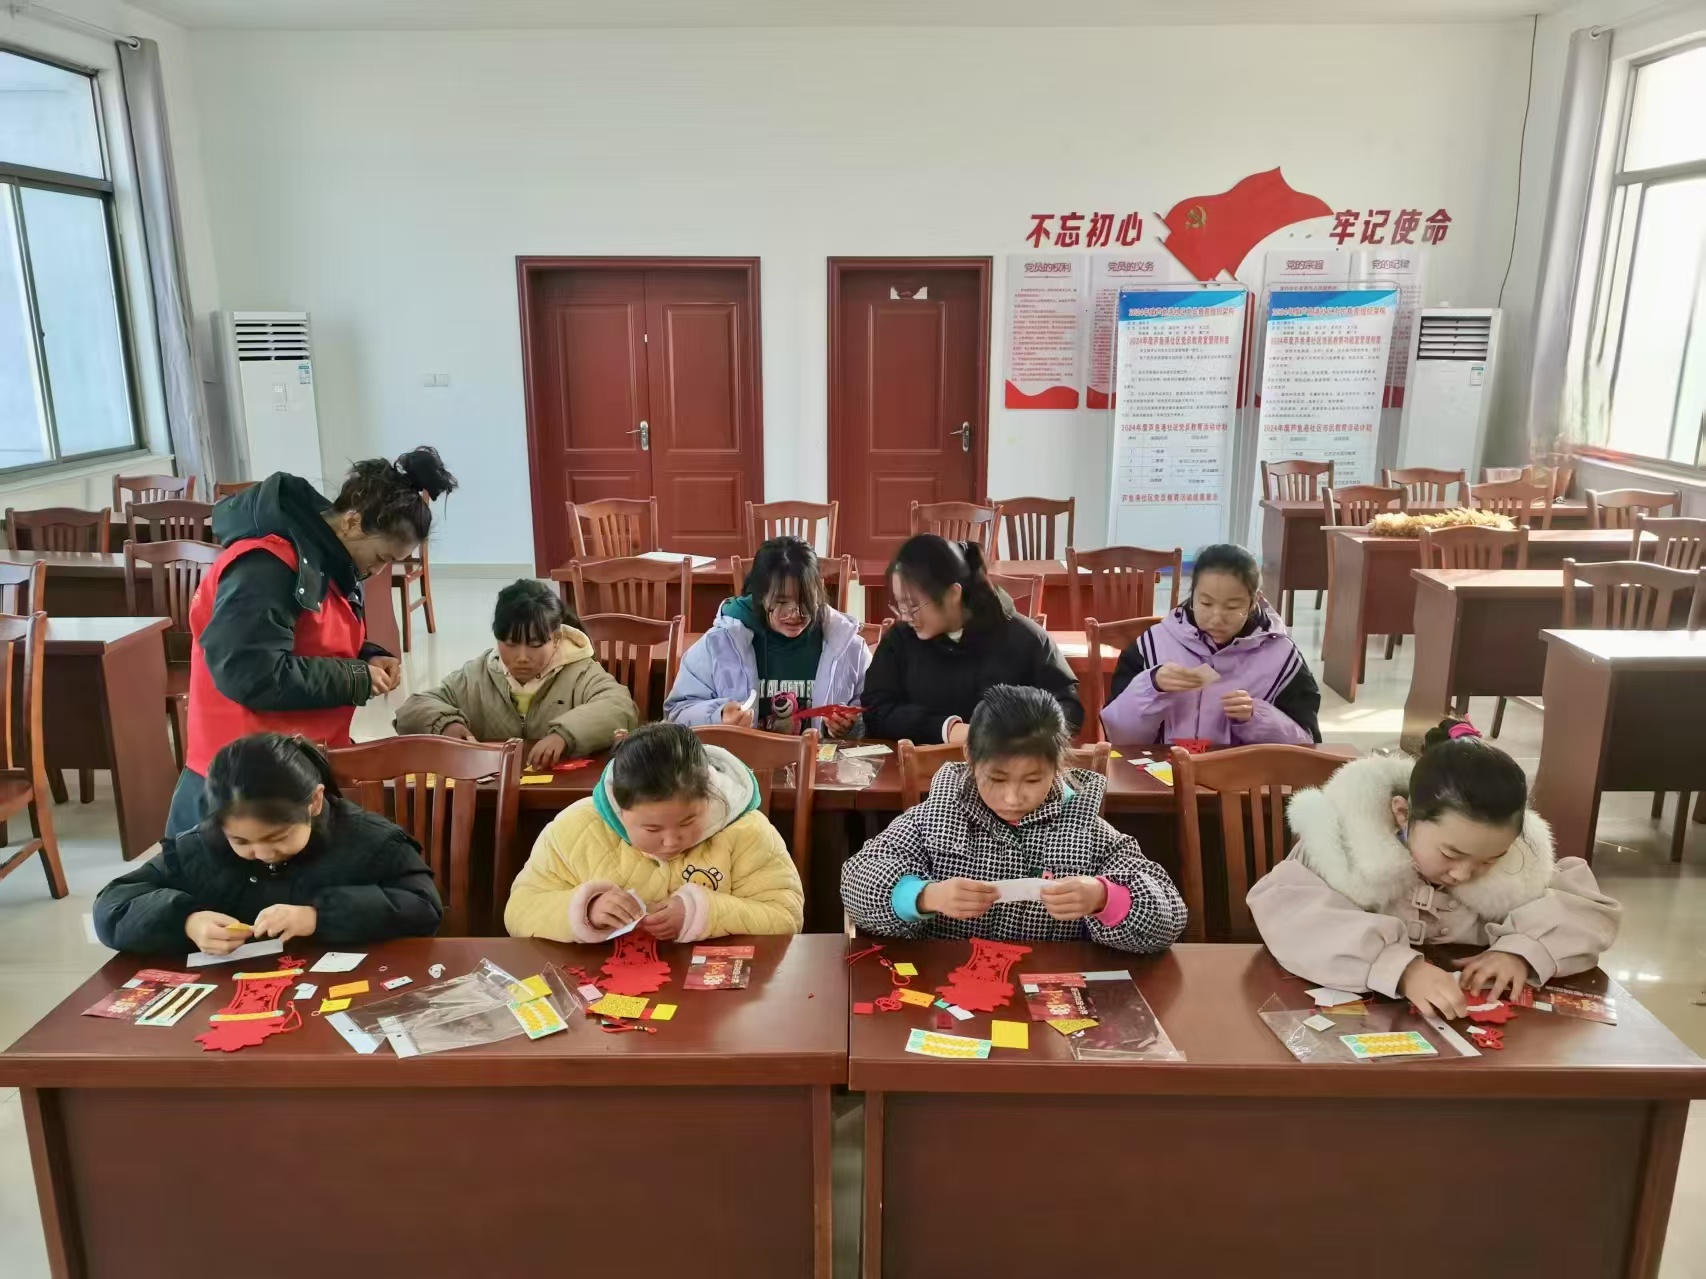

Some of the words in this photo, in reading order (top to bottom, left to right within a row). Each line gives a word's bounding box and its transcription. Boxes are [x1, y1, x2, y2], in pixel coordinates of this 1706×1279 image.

[1025, 211, 1143, 248] 不忘初心
[1329, 208, 1453, 246] 牢记使命
[1024, 262, 1071, 272] 党员的权利
[1107, 261, 1154, 272] 党员的义务
[1286, 259, 1325, 270] 党的宗旨
[1372, 259, 1410, 270] 党的纪律
